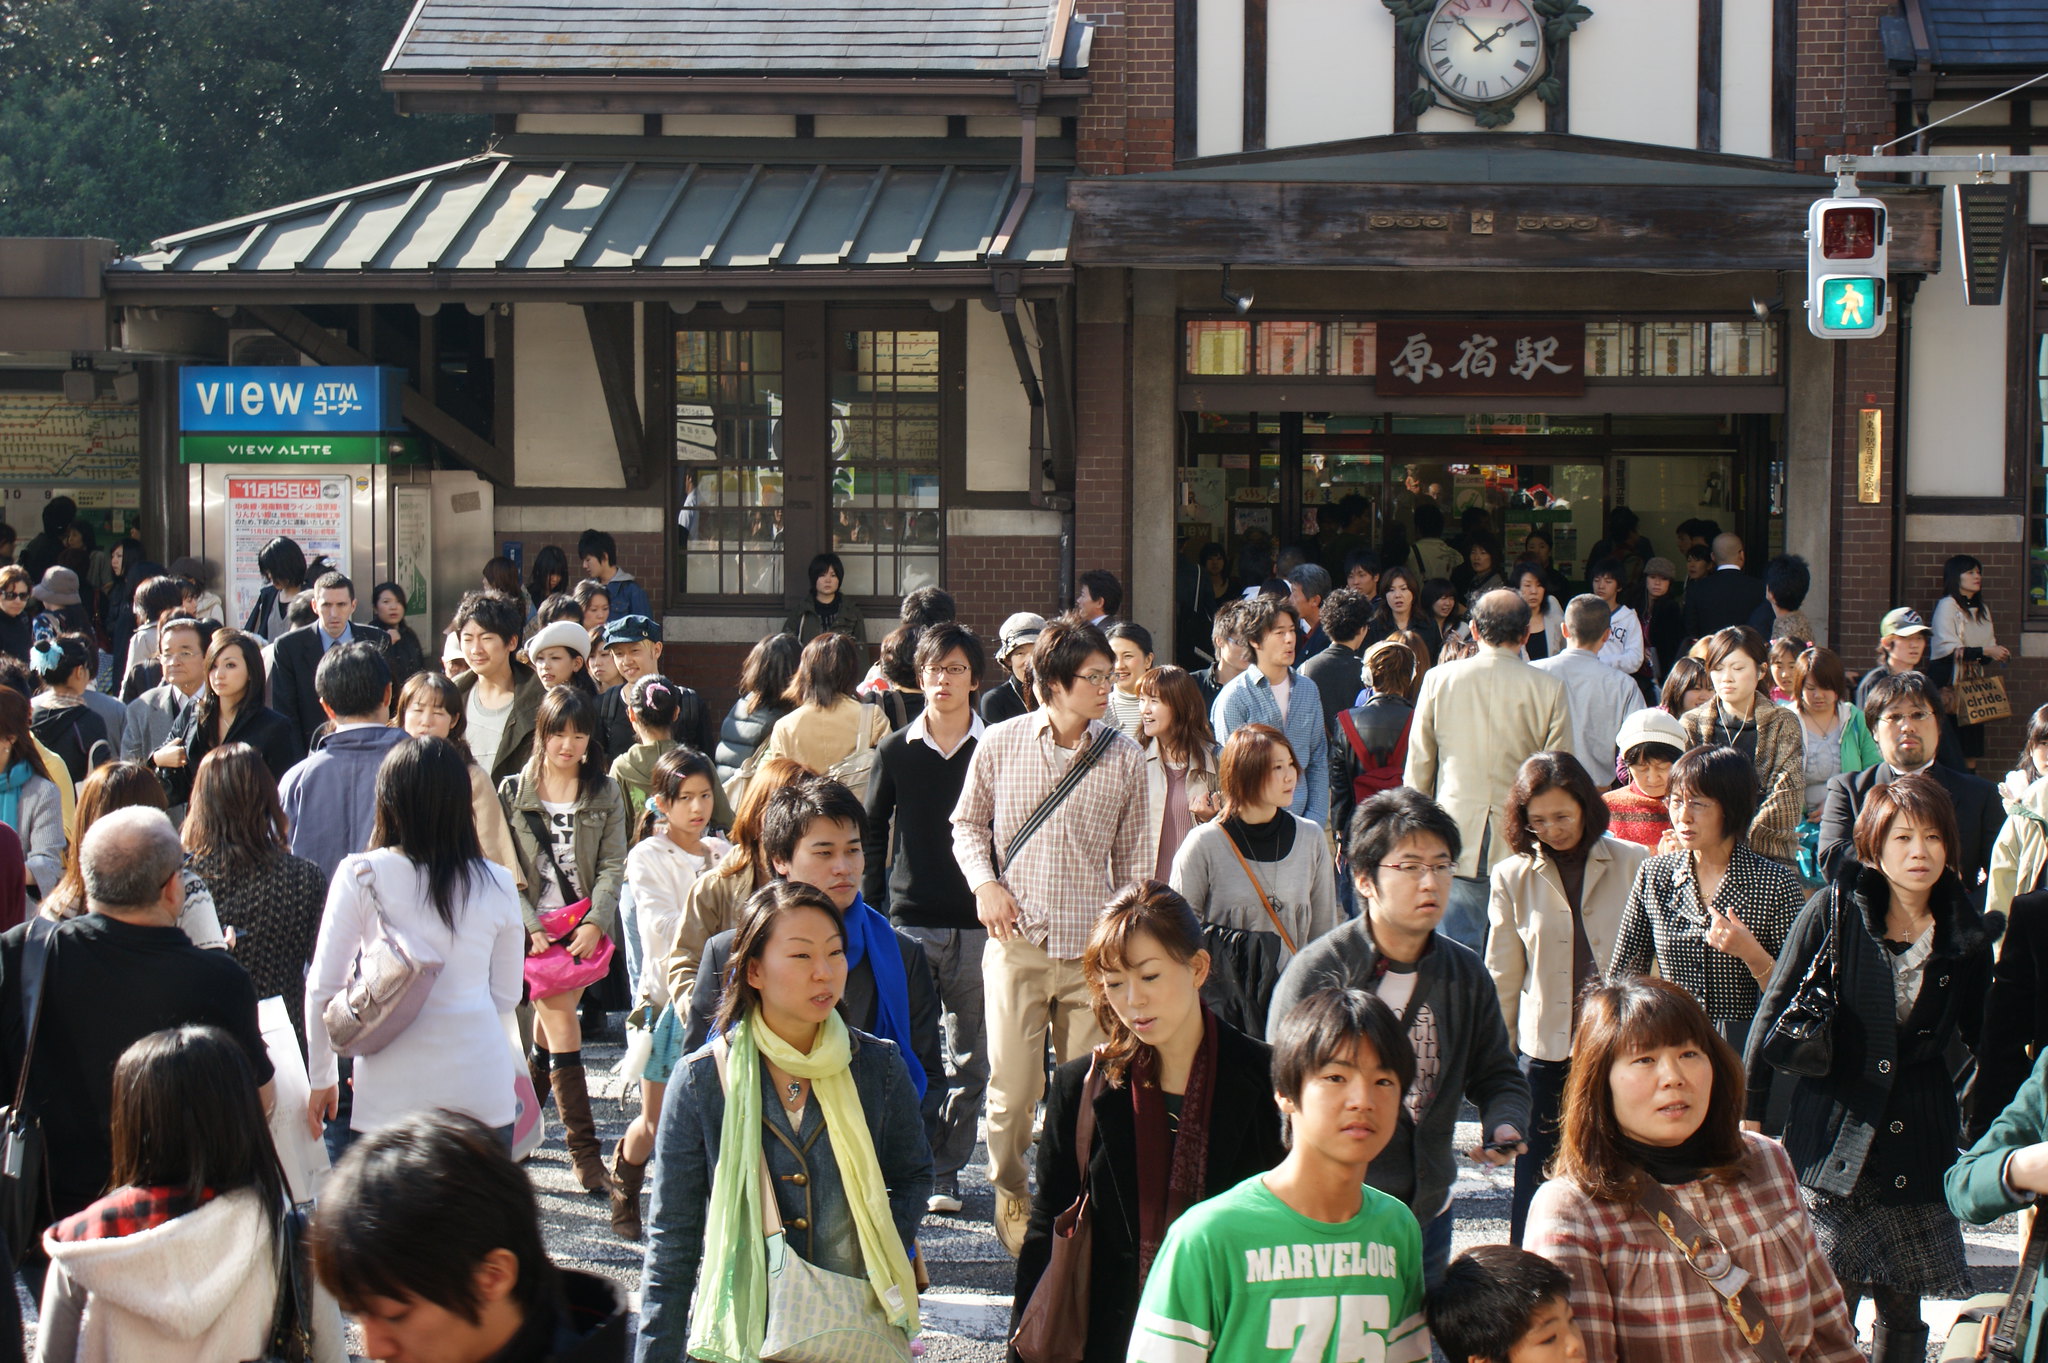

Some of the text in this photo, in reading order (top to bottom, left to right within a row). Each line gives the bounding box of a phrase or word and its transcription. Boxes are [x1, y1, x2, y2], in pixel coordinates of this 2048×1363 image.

[1390, 332, 1574, 385] 原宿駅
[314, 383, 358, 401] ATM
[314, 400, 362, 416] コーナー
[227, 445, 332, 455] VIEW ALTTE
[1962, 682, 1997, 694] www.
[1970, 706, 1998, 719] com
[1245, 1241, 1397, 1283] MARVELOUS
